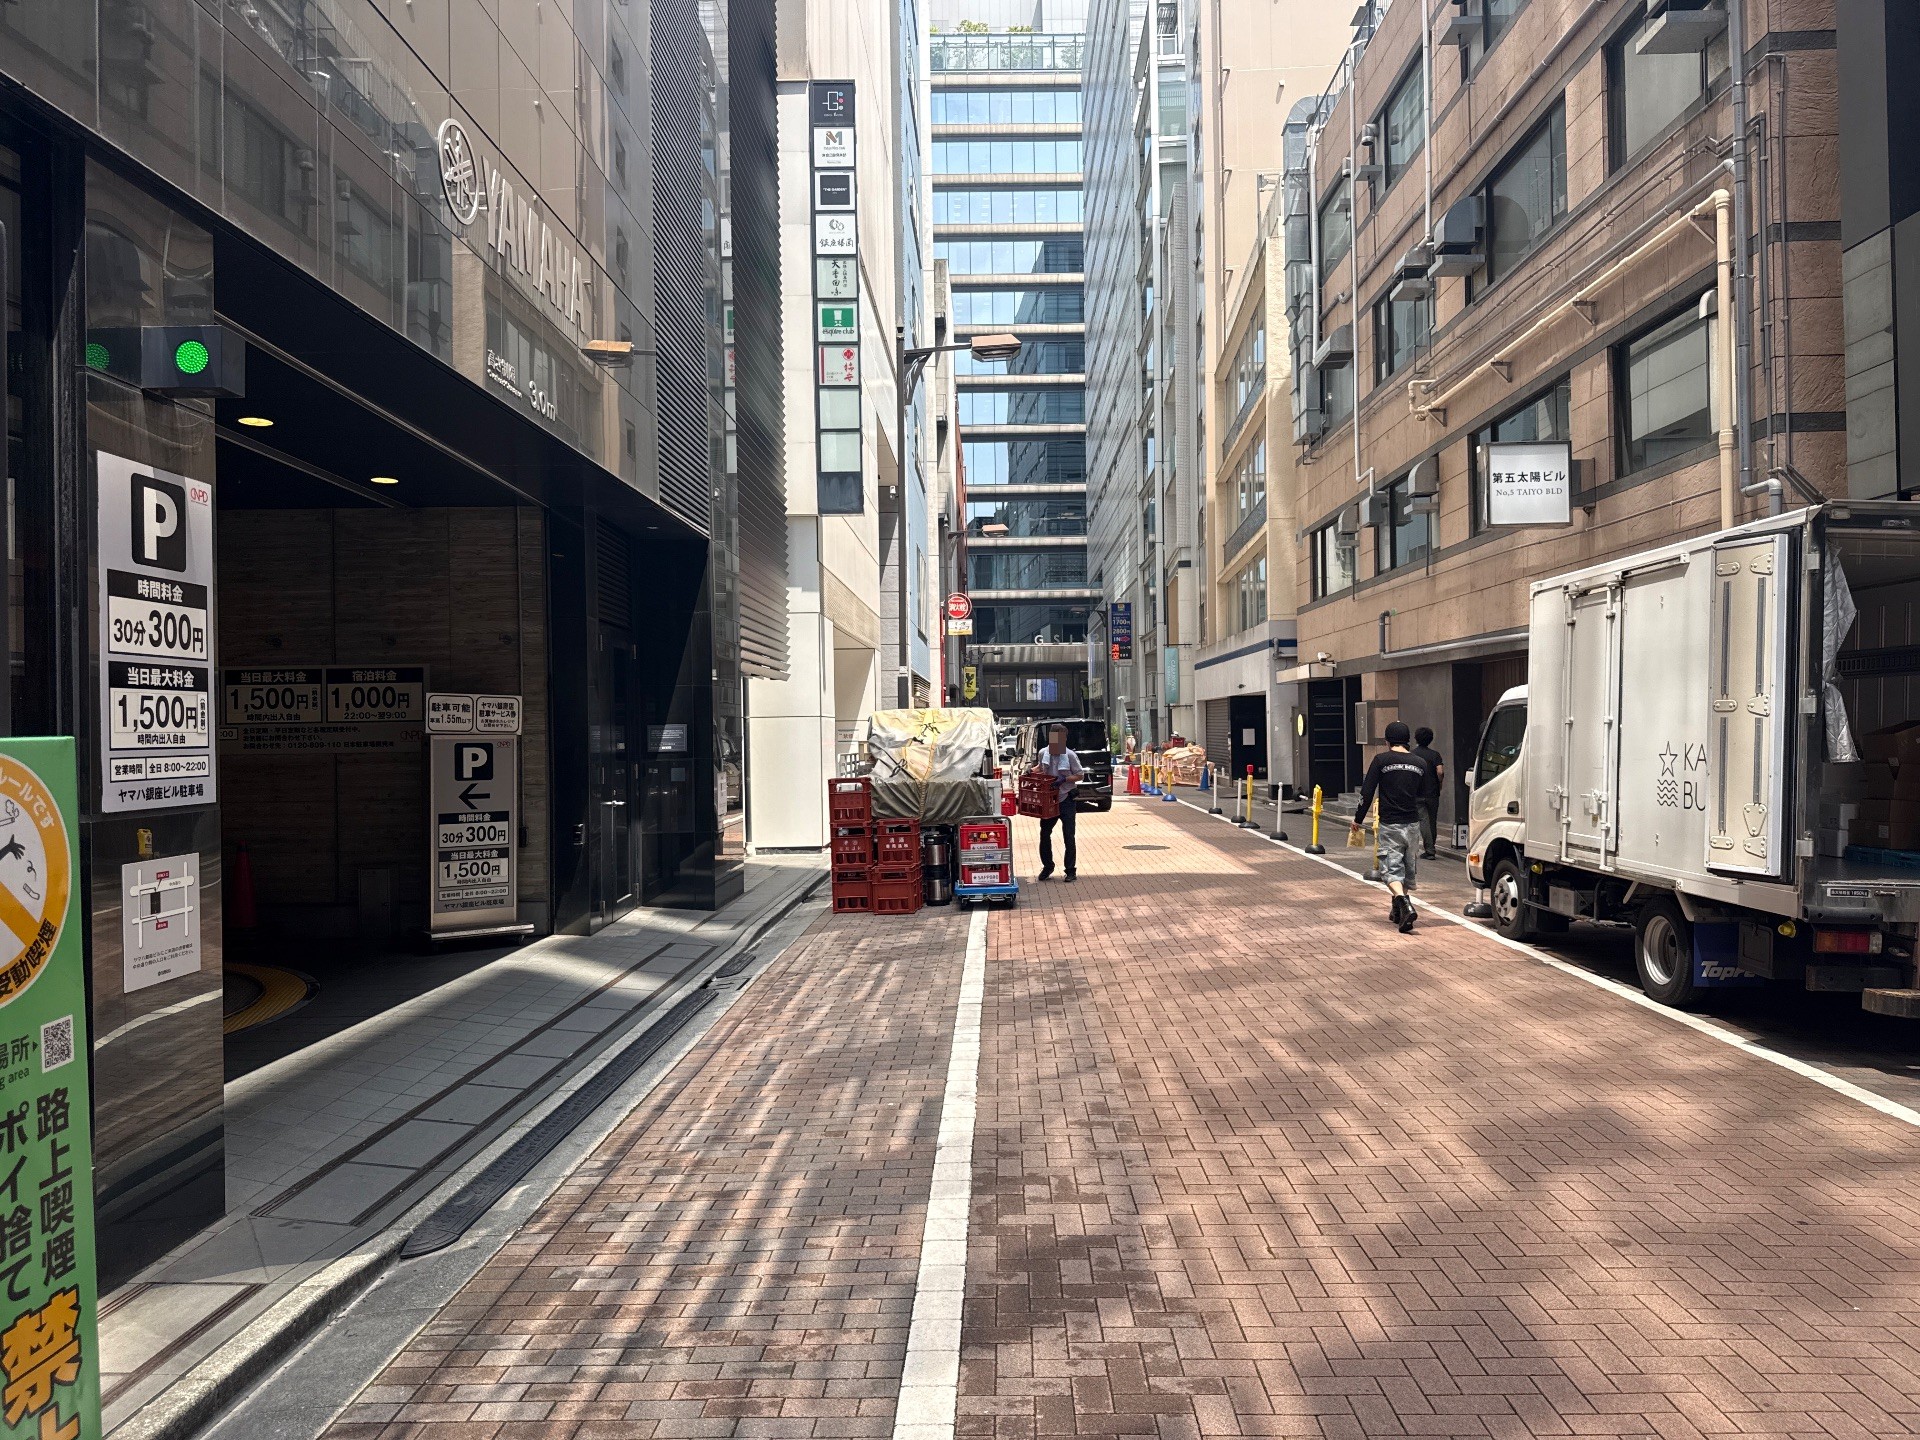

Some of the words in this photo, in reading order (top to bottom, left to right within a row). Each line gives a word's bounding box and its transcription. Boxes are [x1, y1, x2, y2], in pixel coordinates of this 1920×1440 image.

[481, 155, 586, 334] YAMAHA
[822, 328, 842, 336] esquire
[529, 380, 556, 422] 3.0m
[1492, 471, 1566, 484] 第五太陽ビル
[1517, 488, 1543, 496] TAIYO
[143, 486, 178, 561] P
[138, 580, 184, 603] 時間料金
[114, 610, 204, 654] 30分300円
[128, 666, 195, 688] 当日最大料金
[240, 671, 307, 683] 当日最大料金
[352, 670, 398, 682] 宿泊料金
[230, 688, 309, 712] 1,500円
[331, 686, 410, 712] 1,000円
[432, 702, 471, 712] 駐車可能
[118, 694, 197, 732] 1,500円
[246, 713, 301, 722] 時間内出入自由
[479, 710, 516, 718] 駐車サービス券
[138, 734, 186, 745] 時間内出入自由
[114, 764, 143, 776] 営業時間
[149, 764, 162, 774] 全日
[462, 747, 488, 778] P
[118, 784, 204, 803] ヤマハ銀座ビル駐車場
[458, 813, 491, 823] 時間料金
[442, 826, 506, 844] 30分300円
[450, 849, 499, 860] 当日最大料金
[444, 861, 500, 880] 1,500円
[8, 1067, 30, 1084] area
[36, 1086, 76, 1287] 路上喫煙
